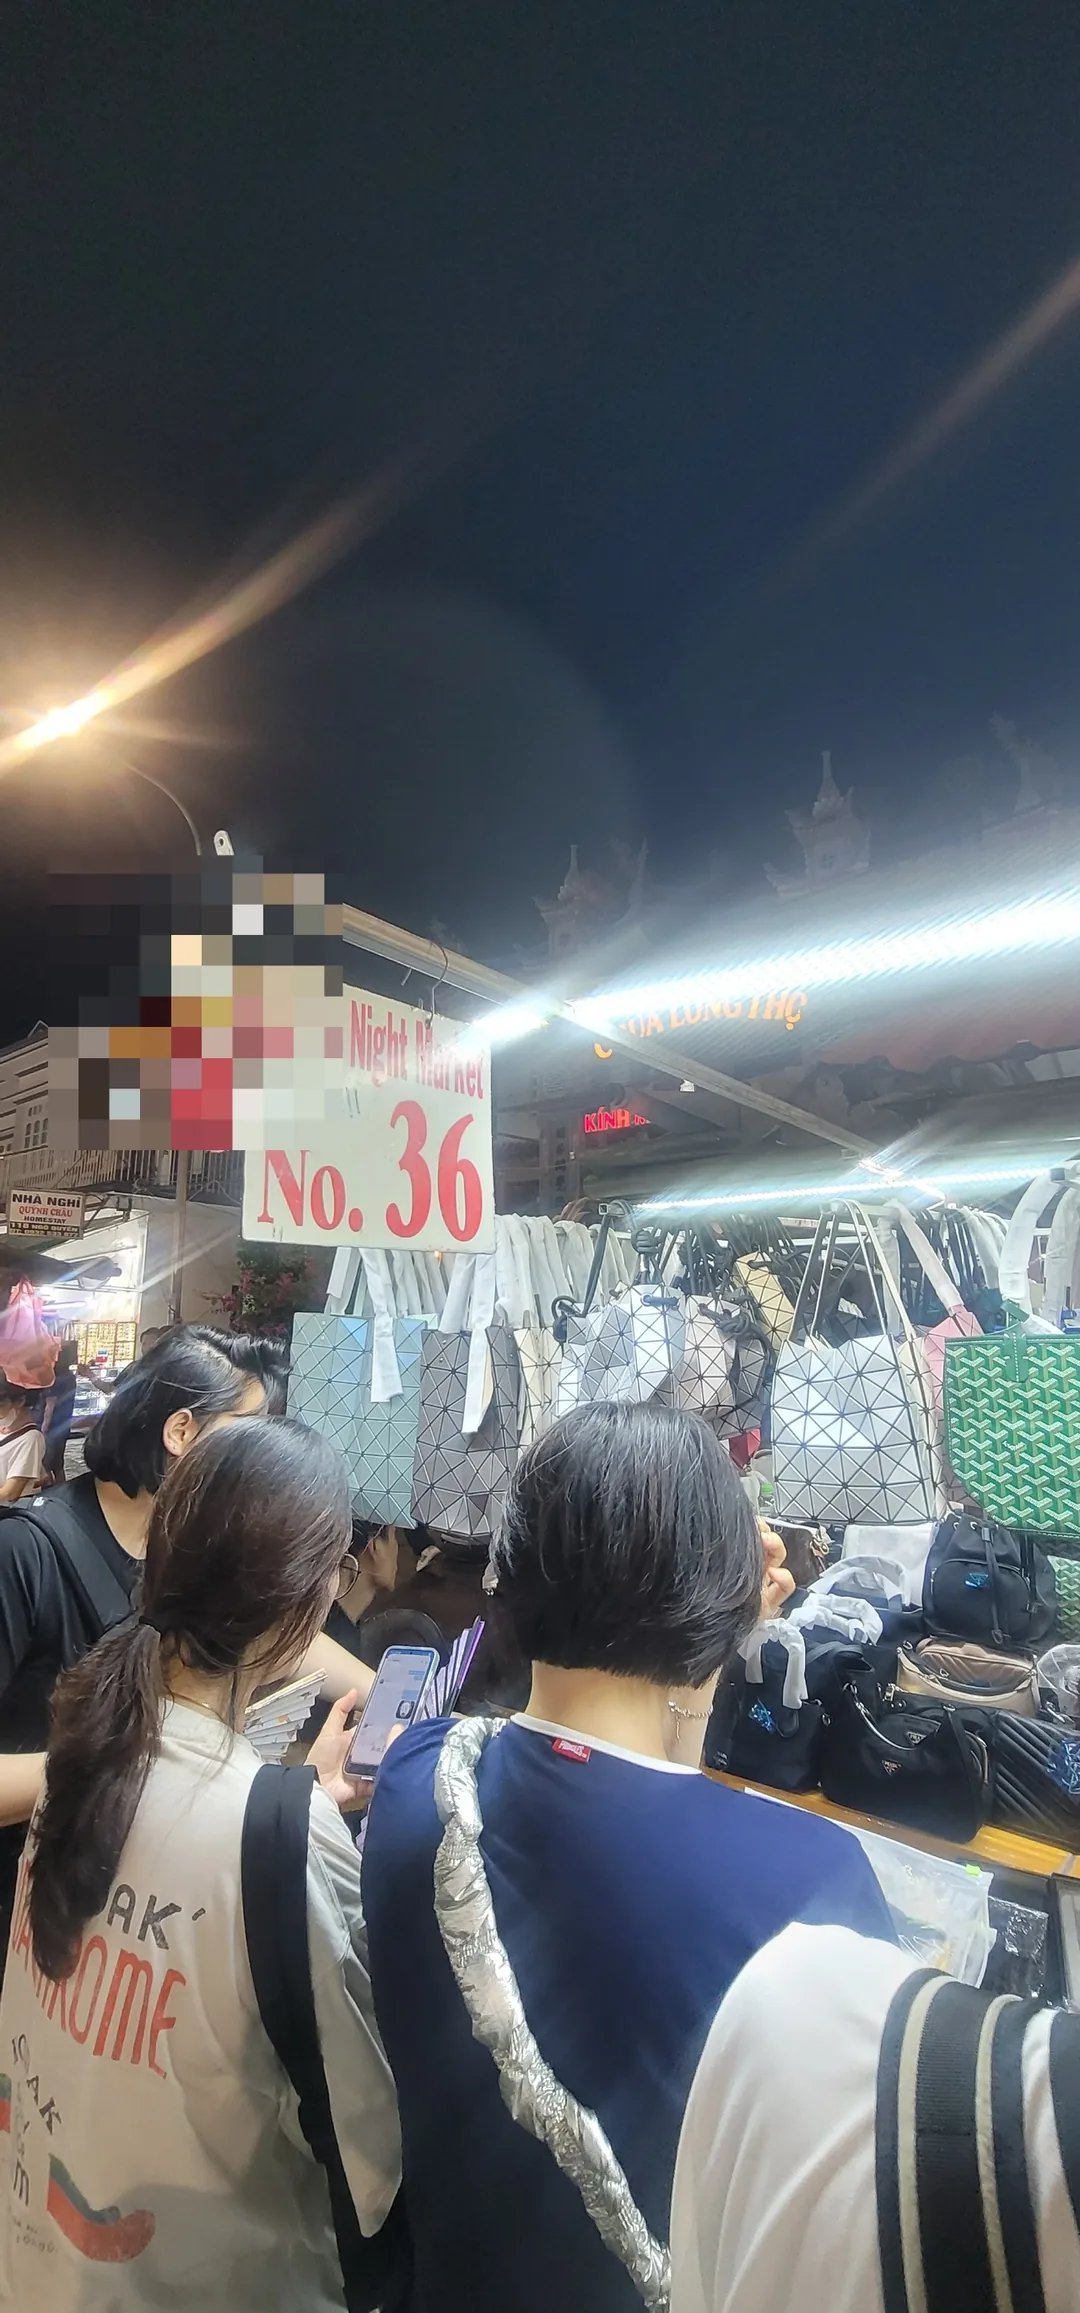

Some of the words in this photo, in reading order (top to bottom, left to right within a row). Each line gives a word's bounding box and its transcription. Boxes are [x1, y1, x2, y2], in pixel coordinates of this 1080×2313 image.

[351, 1000, 408, 1088] Night
[416, 1020, 484, 1099] Market
[584, 1107, 631, 1133] KÍNH
[257, 1150, 364, 1233] No.
[385, 1100, 484, 1243] 36
[12, 1194, 42, 1205] NHÀ
[47, 1196, 81, 1208] NGHỈ
[24, 1215, 67, 1224] HOMESTAY
